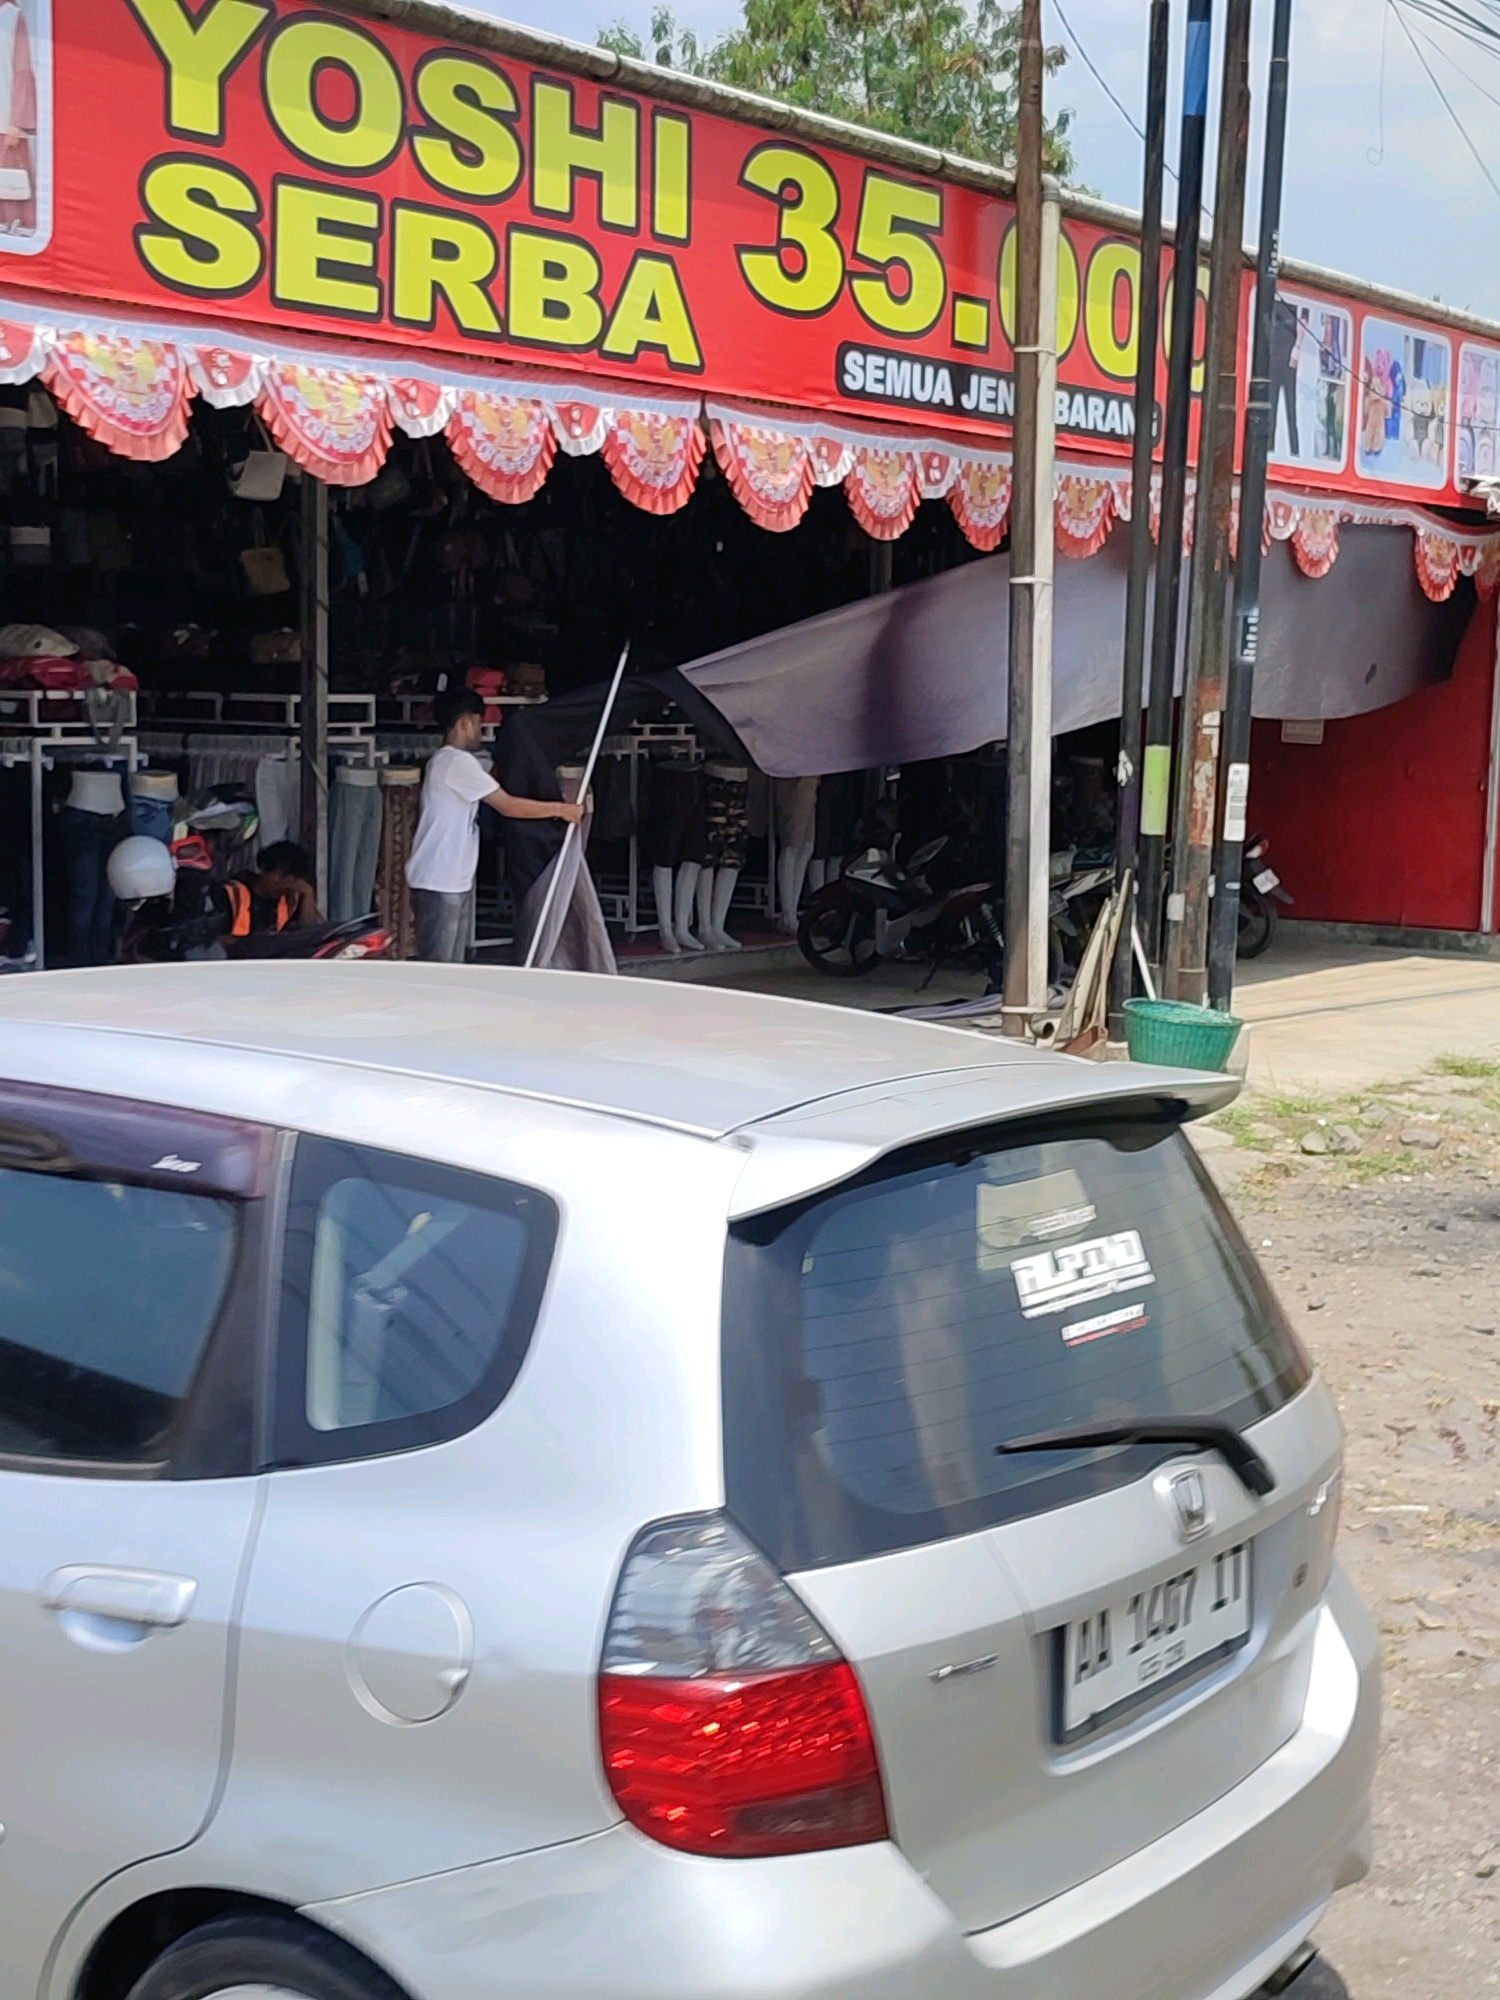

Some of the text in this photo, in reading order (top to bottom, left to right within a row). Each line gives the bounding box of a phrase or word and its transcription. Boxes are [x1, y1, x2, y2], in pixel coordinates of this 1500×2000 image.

[132, 0, 692, 242] YOSHI
[135, 157, 702, 370] SERBA
[843, 350, 1159, 437] SEMUA JEN BARAN
